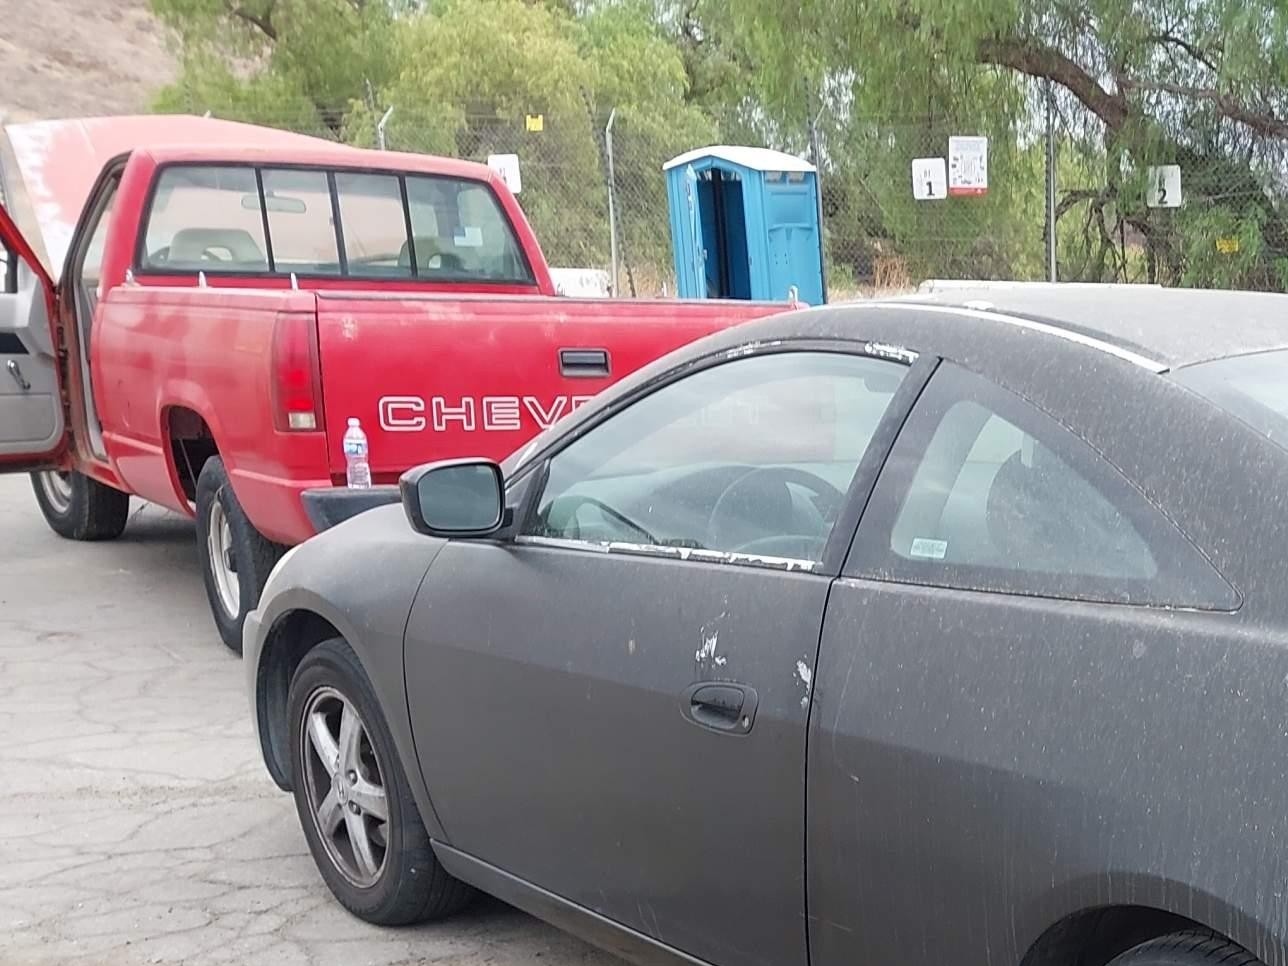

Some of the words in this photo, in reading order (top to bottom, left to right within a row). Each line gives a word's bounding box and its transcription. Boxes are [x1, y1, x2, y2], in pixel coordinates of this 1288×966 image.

[925, 181, 935, 196] 1
[1157, 188, 1168, 204] 2
[378, 395, 597, 432] CHEV
